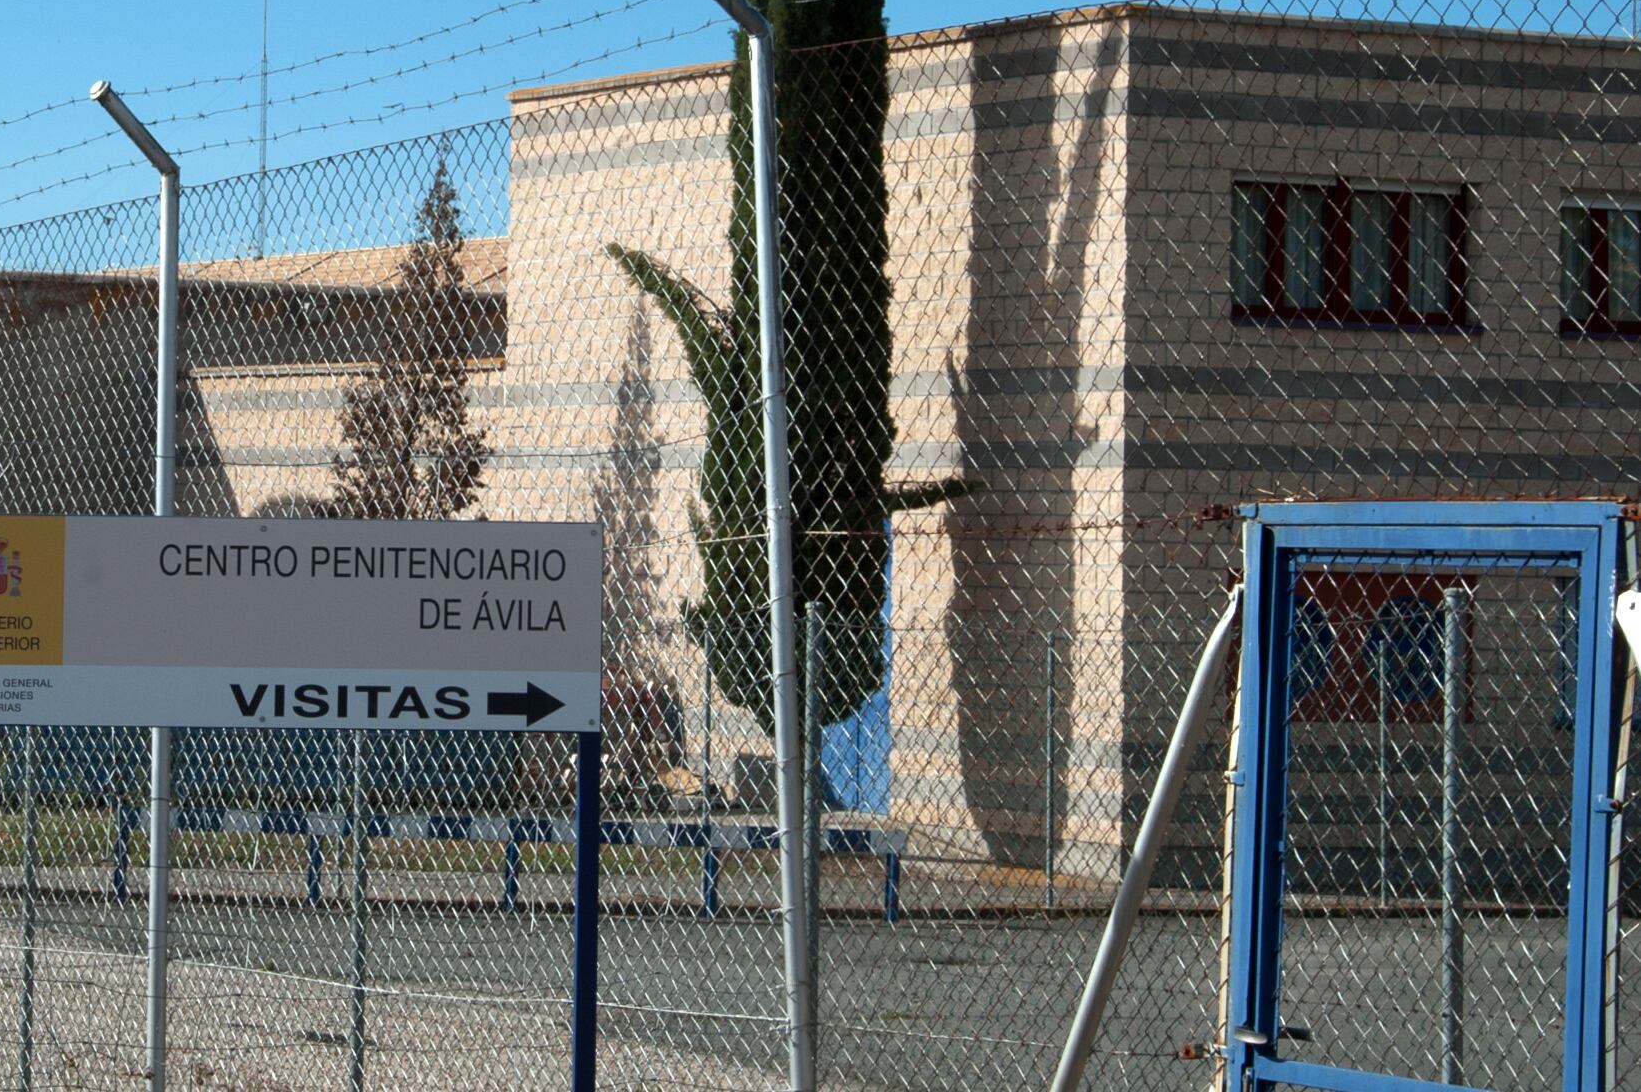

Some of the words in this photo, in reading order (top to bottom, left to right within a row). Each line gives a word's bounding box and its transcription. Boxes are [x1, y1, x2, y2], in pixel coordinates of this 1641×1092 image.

[159, 543, 299, 578] CENTRO
[311, 545, 567, 582] PENITENCIARIO
[419, 598, 462, 630] DE
[472, 590, 567, 632] ÁVILA
[2, 678, 53, 688] GENERAL
[229, 683, 472, 720] VISITAS
